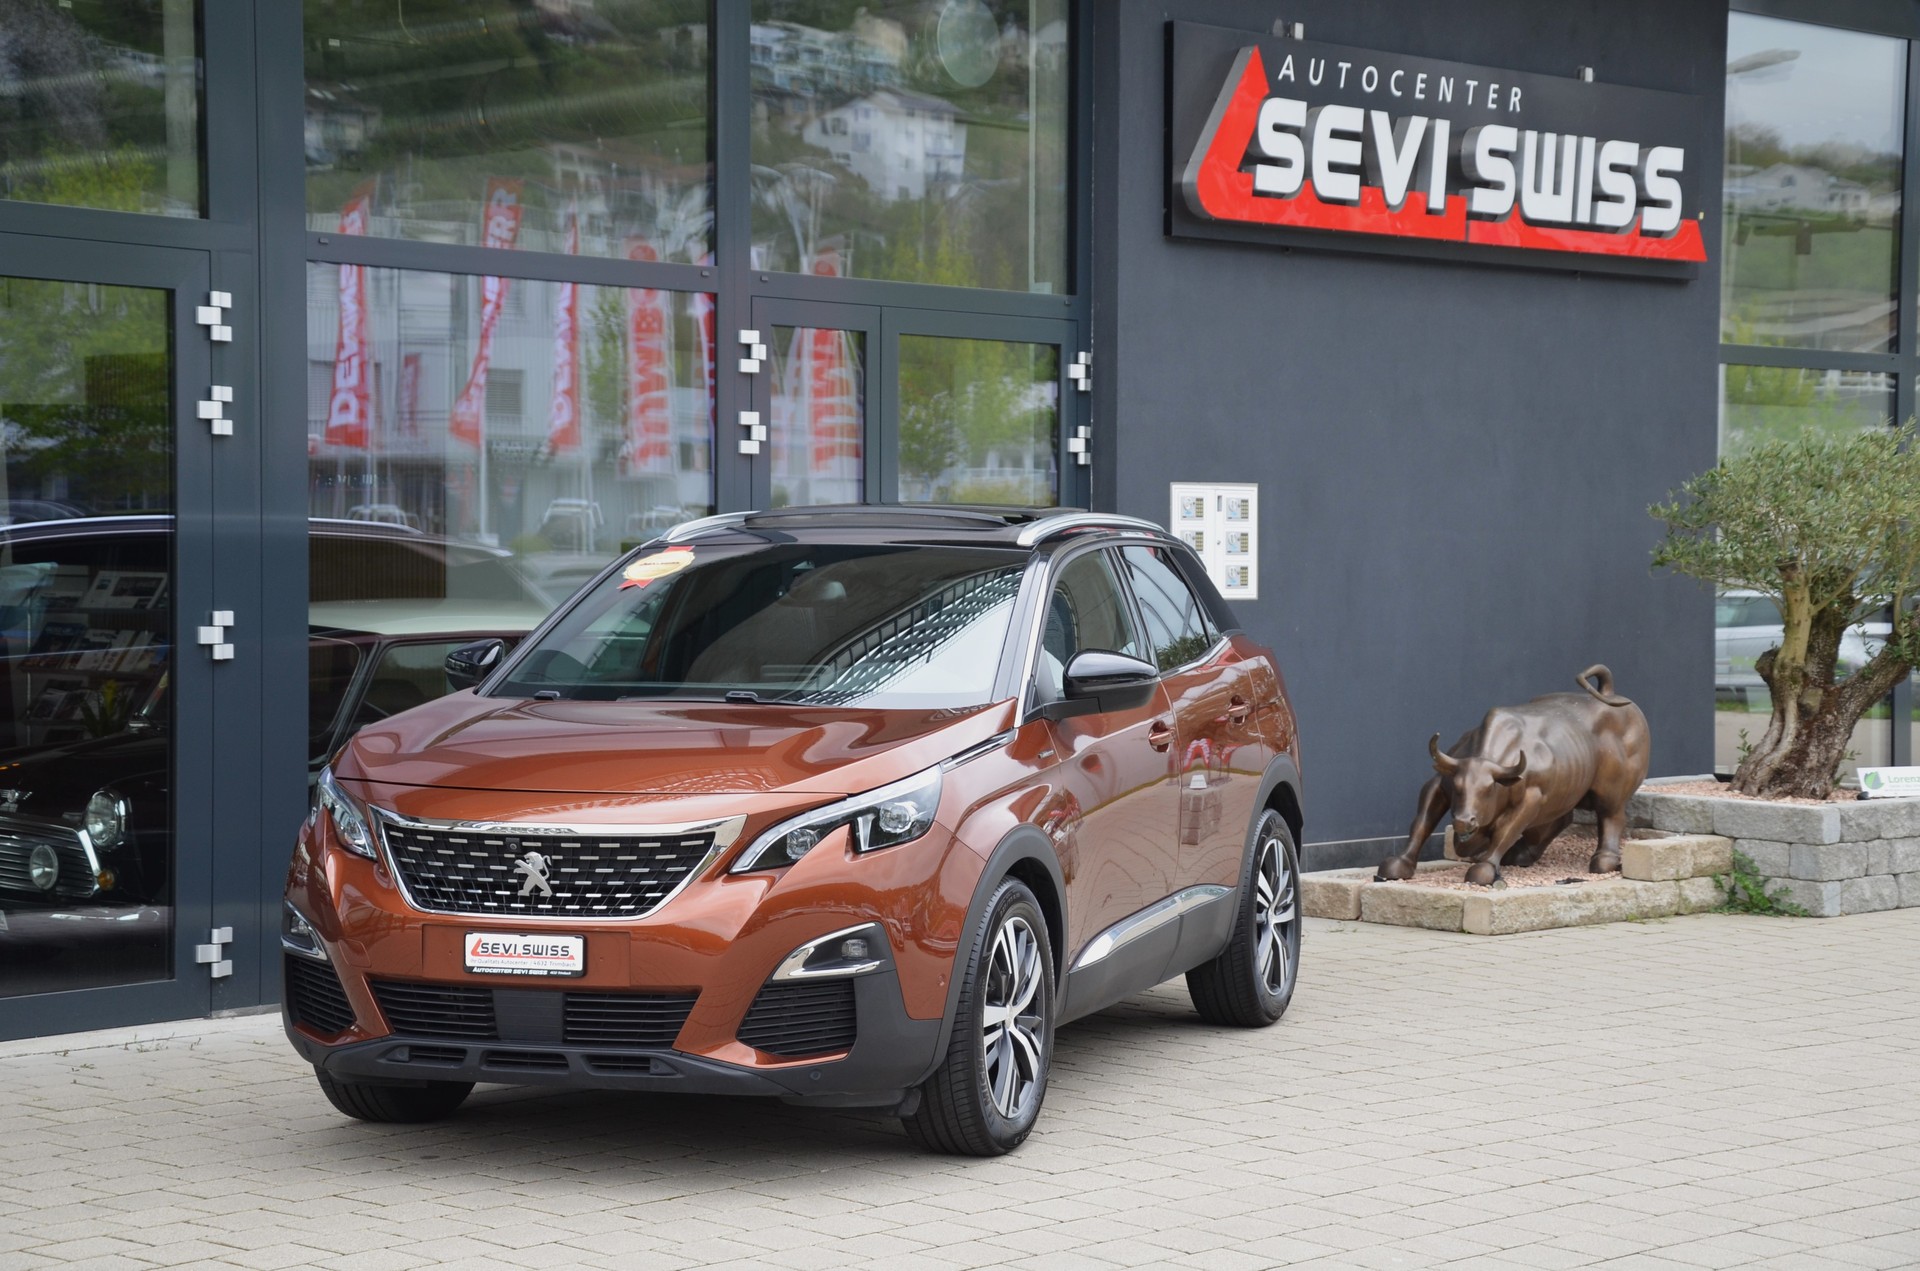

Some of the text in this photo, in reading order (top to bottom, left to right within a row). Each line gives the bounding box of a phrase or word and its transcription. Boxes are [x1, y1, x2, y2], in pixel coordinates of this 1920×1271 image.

[1278, 54, 1522, 112] AUTOCENTER
[1252, 97, 1684, 234] SEVI SWISS
[480, 942, 570, 957] SEVI SWISS
